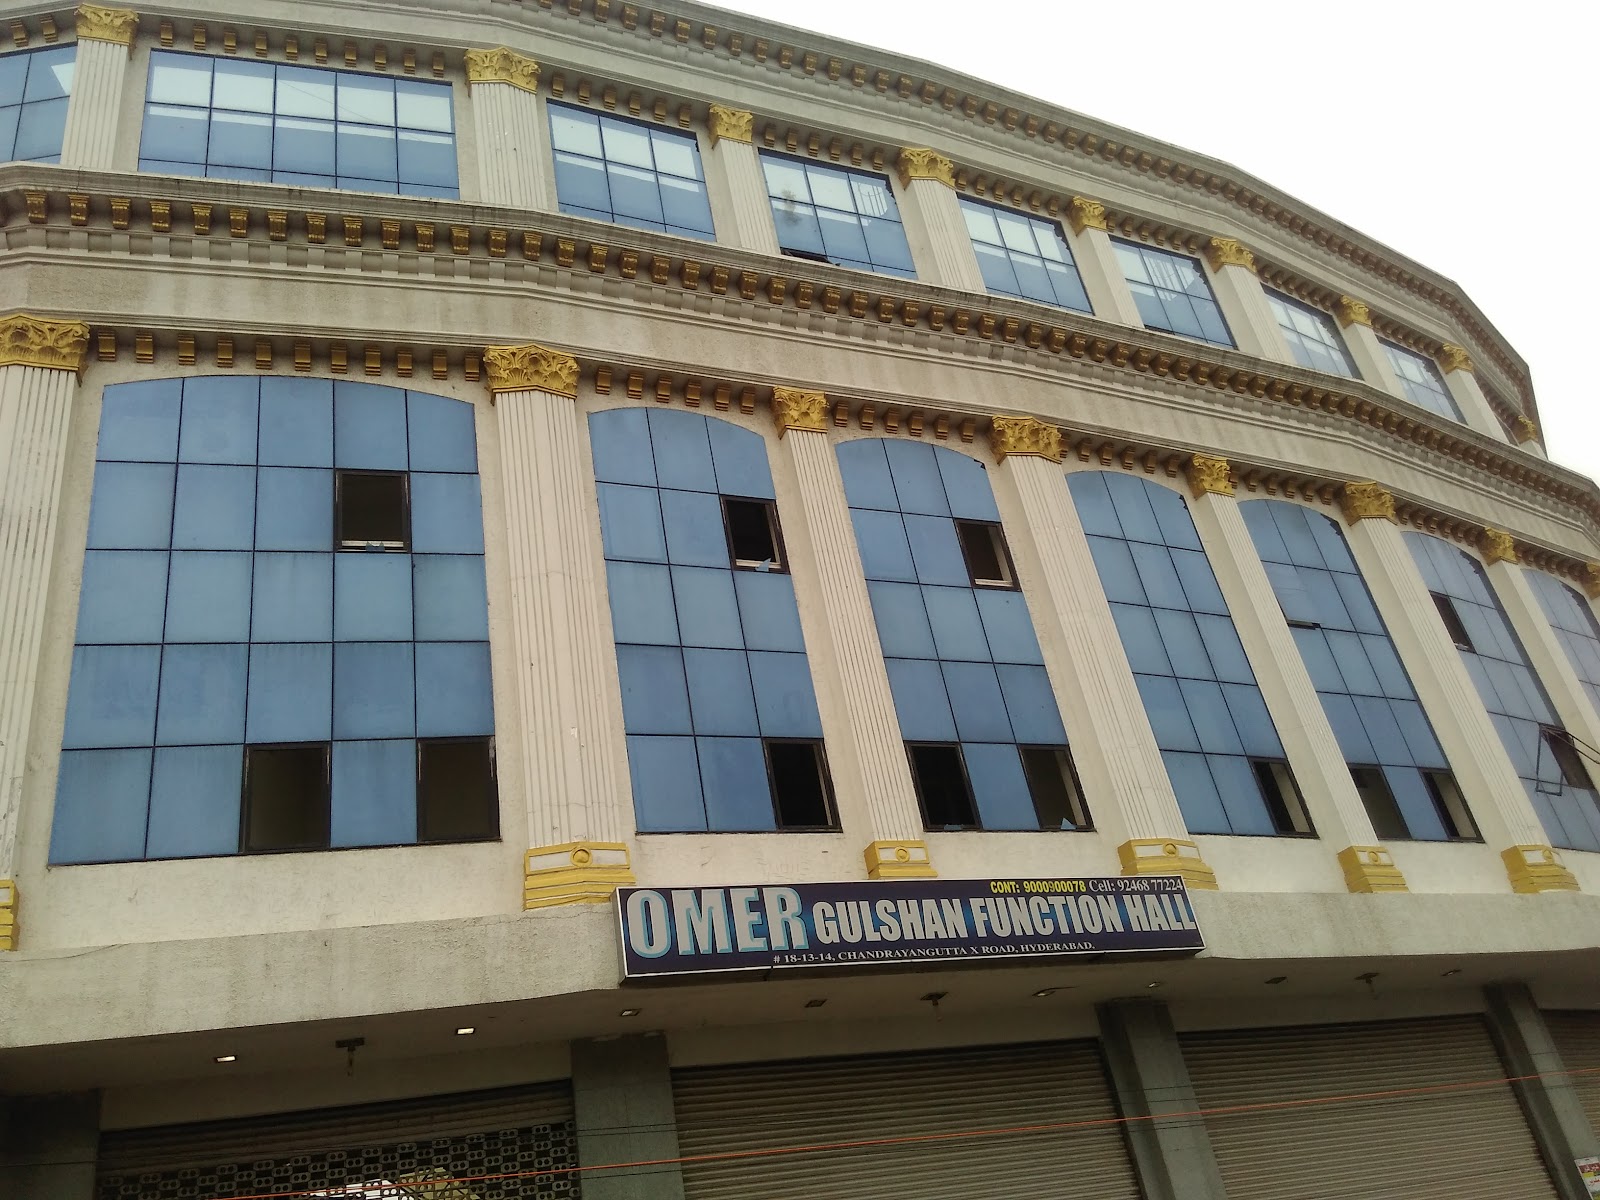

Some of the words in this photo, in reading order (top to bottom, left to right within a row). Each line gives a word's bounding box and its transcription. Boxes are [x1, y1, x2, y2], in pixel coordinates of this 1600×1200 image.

[990, 881, 1021, 894] CONT:
[1023, 880, 1086, 893] 9000900078
[1088, 879, 1115, 892] Cell:
[1117, 879, 1150, 891] 92468
[1151, 879, 1183, 891] 77224
[626, 887, 809, 959] OMER
[812, 898, 968, 944] GULSHAN
[970, 894, 1124, 937] FUNCTION
[1122, 893, 1197, 932] HALL
[784, 952, 836, 963] 18-13-14,
[838, 947, 967, 960] CHANDRAYANGUTTA
[969, 946, 978, 955] X
[982, 945, 1018, 954] ROAD,
[1020, 942, 1095, 952] HYDERABAD.
